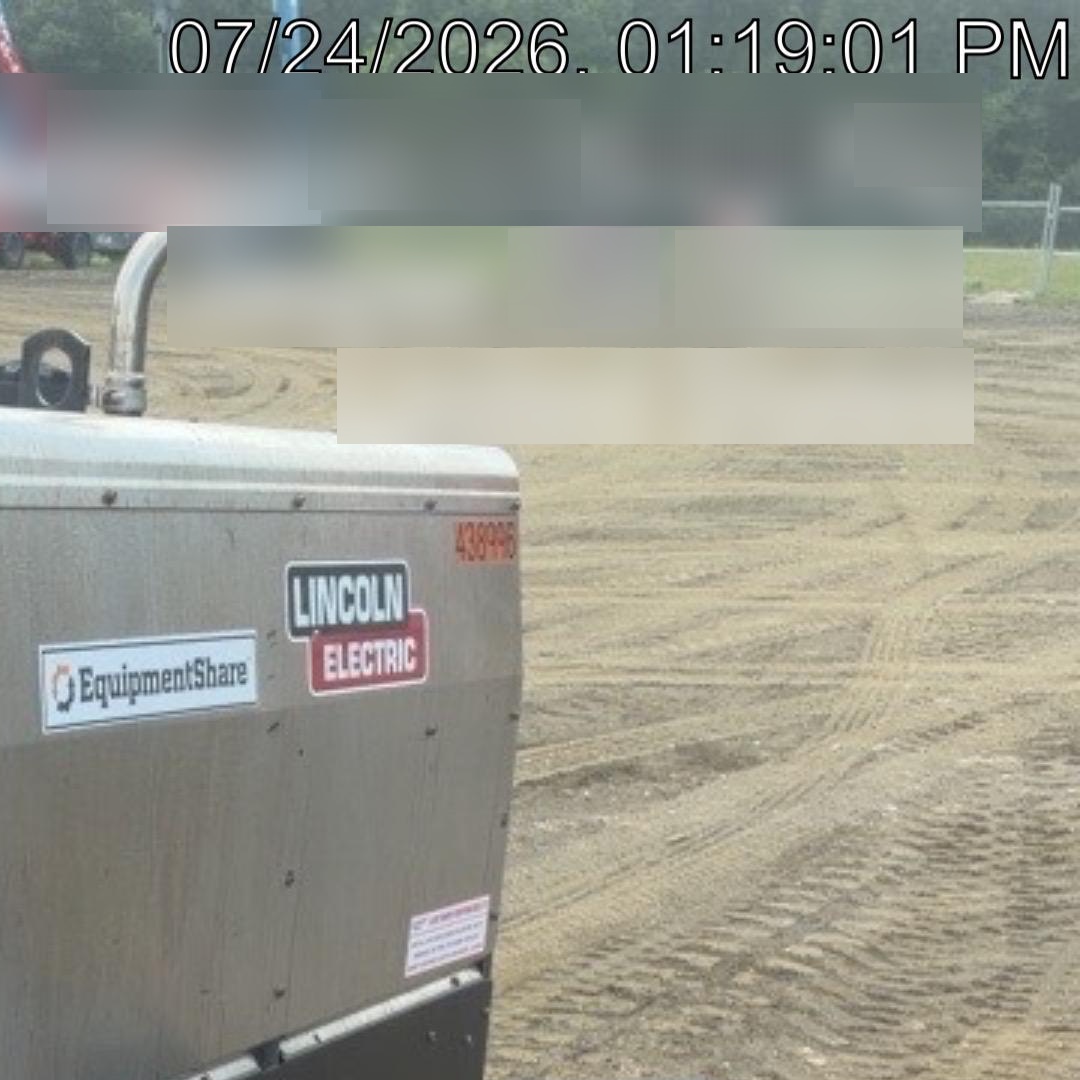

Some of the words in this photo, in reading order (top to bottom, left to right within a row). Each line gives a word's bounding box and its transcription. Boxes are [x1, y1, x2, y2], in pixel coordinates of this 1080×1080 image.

[292, 572, 403, 629] LINCOLN
[77, 656, 250, 709] EquipmentShare
[322, 636, 418, 682] ELECTRIC
